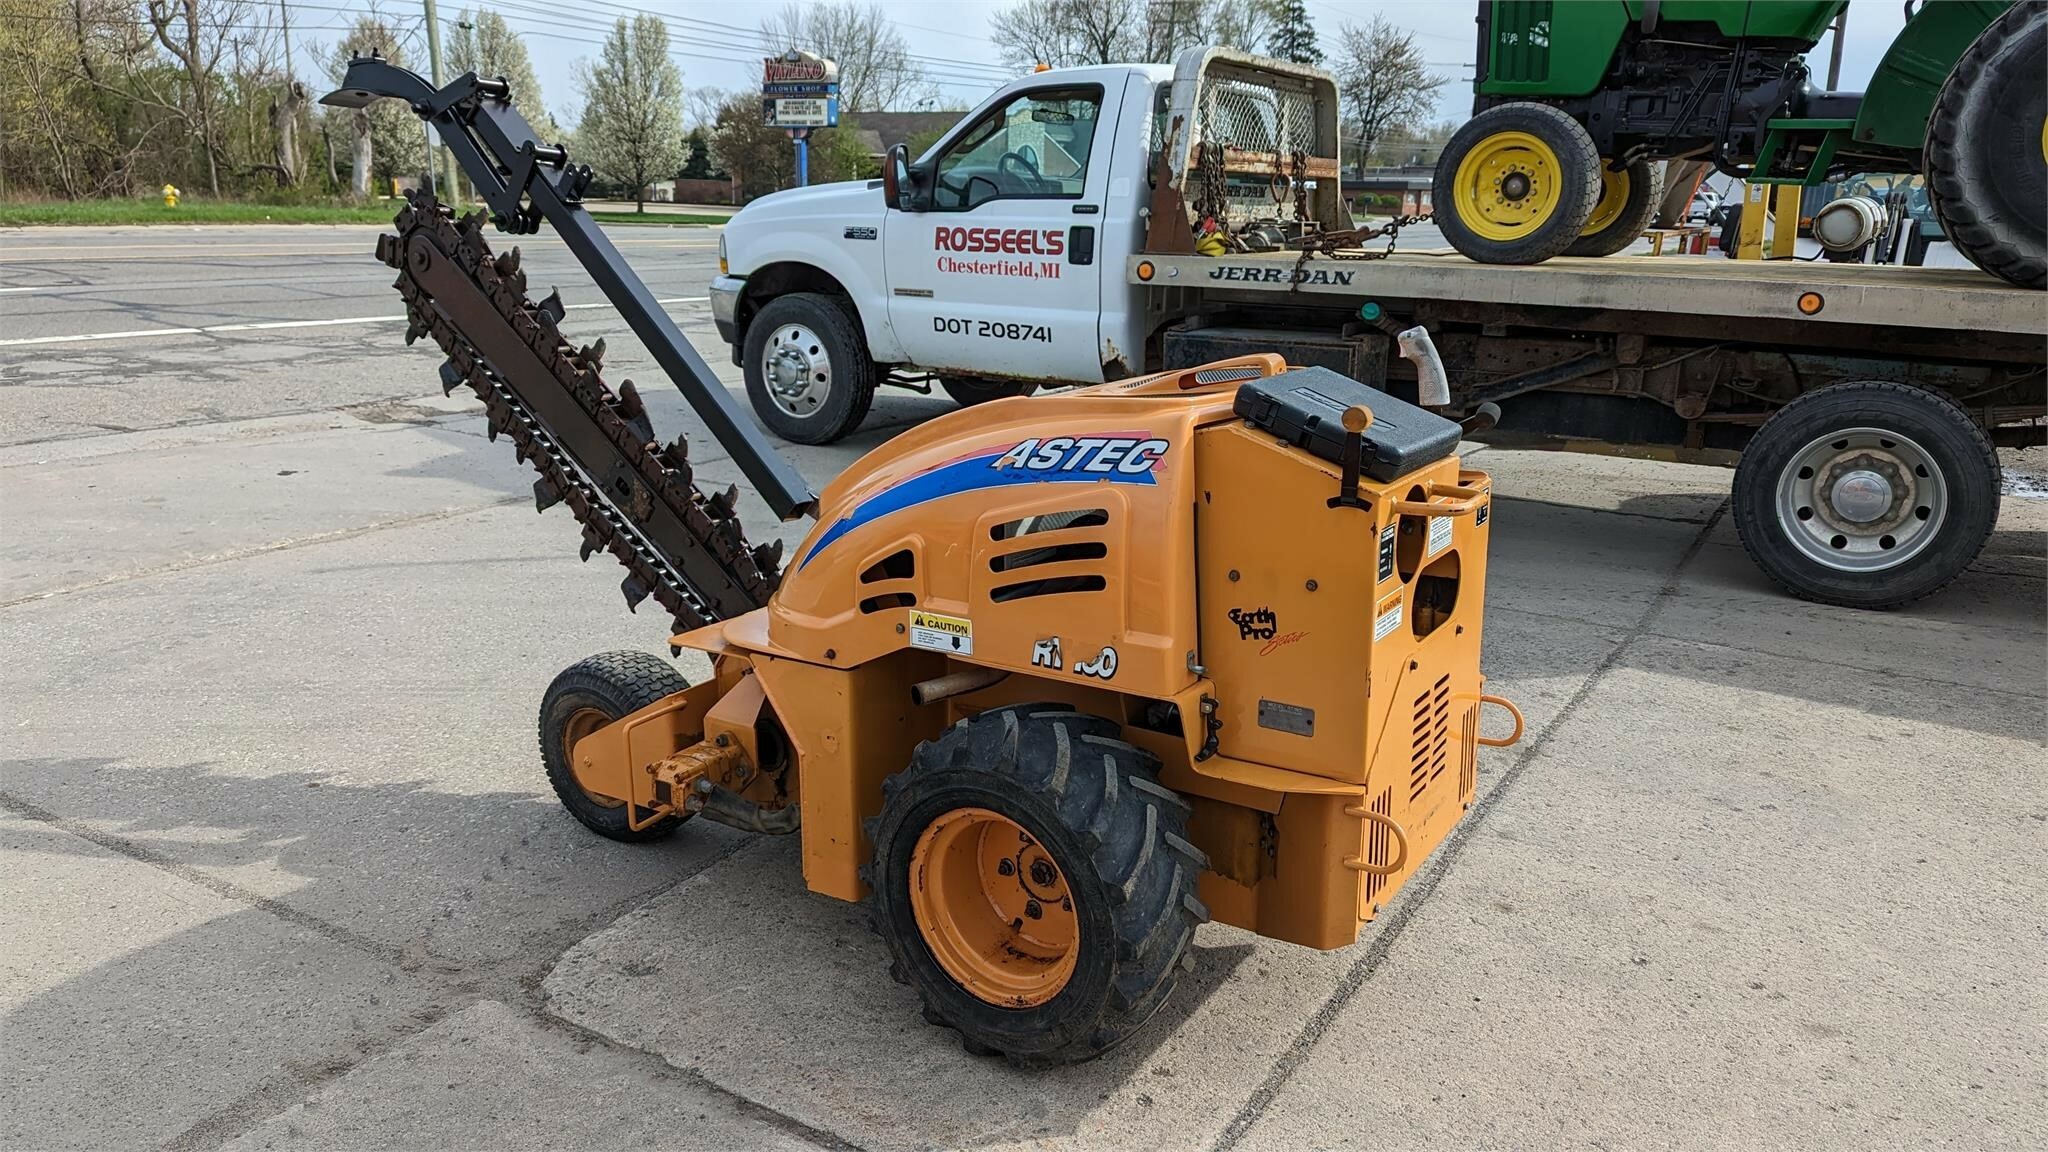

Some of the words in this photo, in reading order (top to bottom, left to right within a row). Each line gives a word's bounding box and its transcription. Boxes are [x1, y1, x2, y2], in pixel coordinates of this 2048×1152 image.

[934, 226, 1064, 256] ROSSEEL'S
[933, 316, 973, 336] DOT
[978, 320, 1053, 343] 208741
[988, 437, 1170, 475] ASTEC
[927, 619, 968, 635] CAUTION
[1239, 622, 1275, 641] Pro
